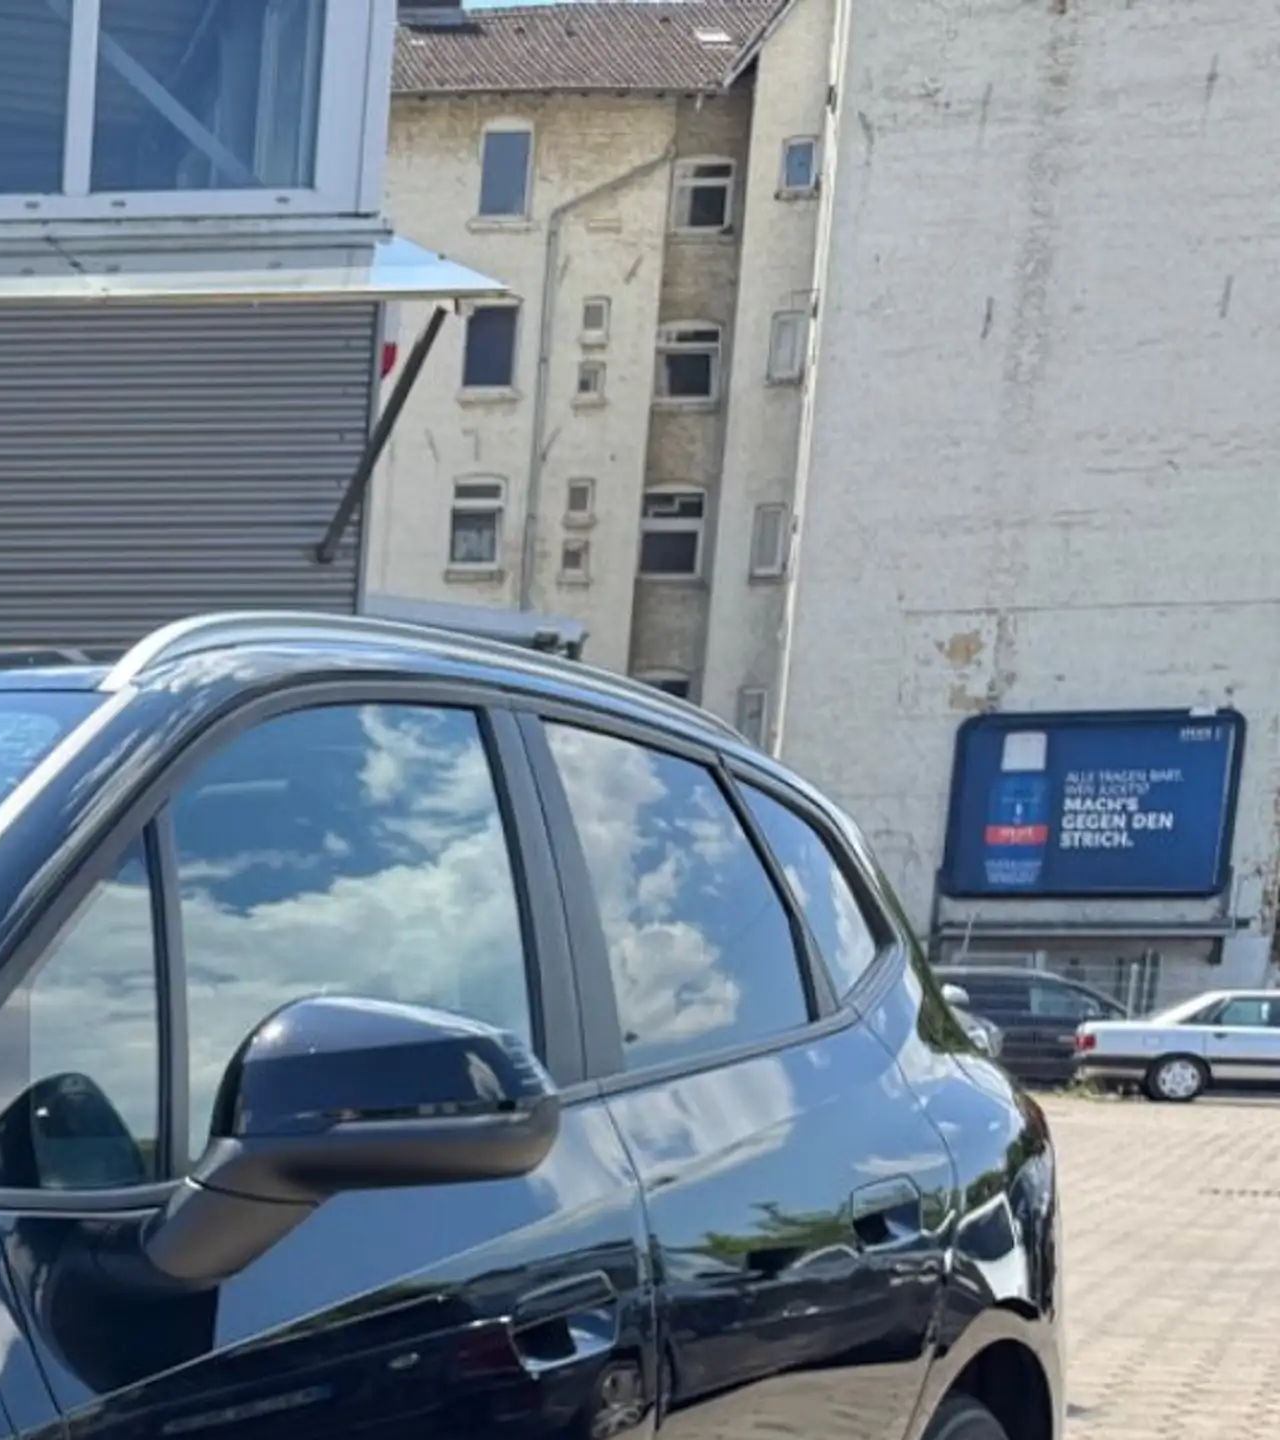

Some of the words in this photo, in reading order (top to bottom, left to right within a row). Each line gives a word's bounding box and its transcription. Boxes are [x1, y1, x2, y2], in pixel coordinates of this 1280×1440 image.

[1063, 797, 1139, 811] MACH'S
[1061, 813, 1127, 830] GEGEN
[1131, 811, 1174, 831] DEN
[1059, 831, 1135, 849] STRICH.
